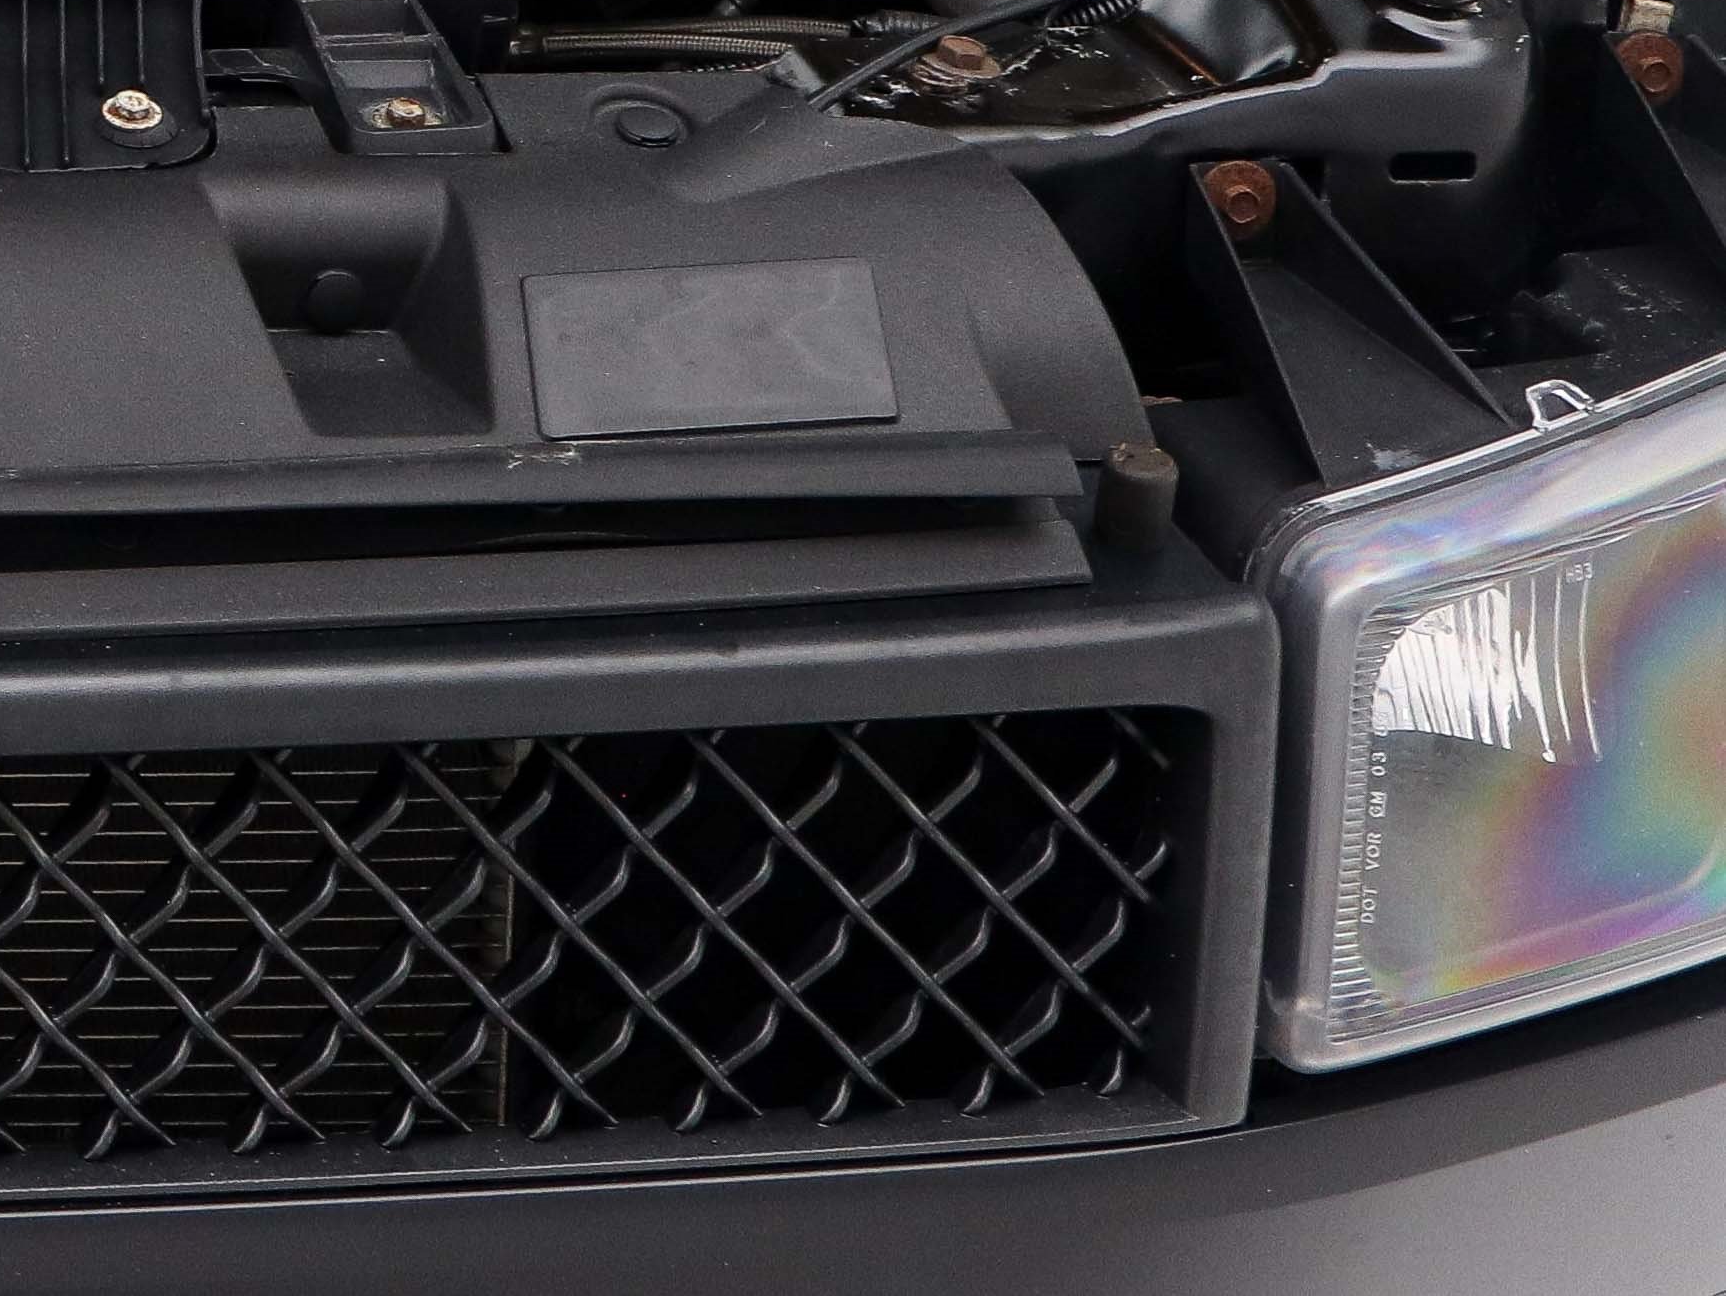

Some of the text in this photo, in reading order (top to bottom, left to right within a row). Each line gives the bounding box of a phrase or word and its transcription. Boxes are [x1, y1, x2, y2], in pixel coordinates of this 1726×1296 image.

[1371, 751, 1386, 777] 03
[1368, 791, 1387, 819] GM
[1365, 832, 1382, 871] VOR
[1360, 887, 1378, 925] DOT
